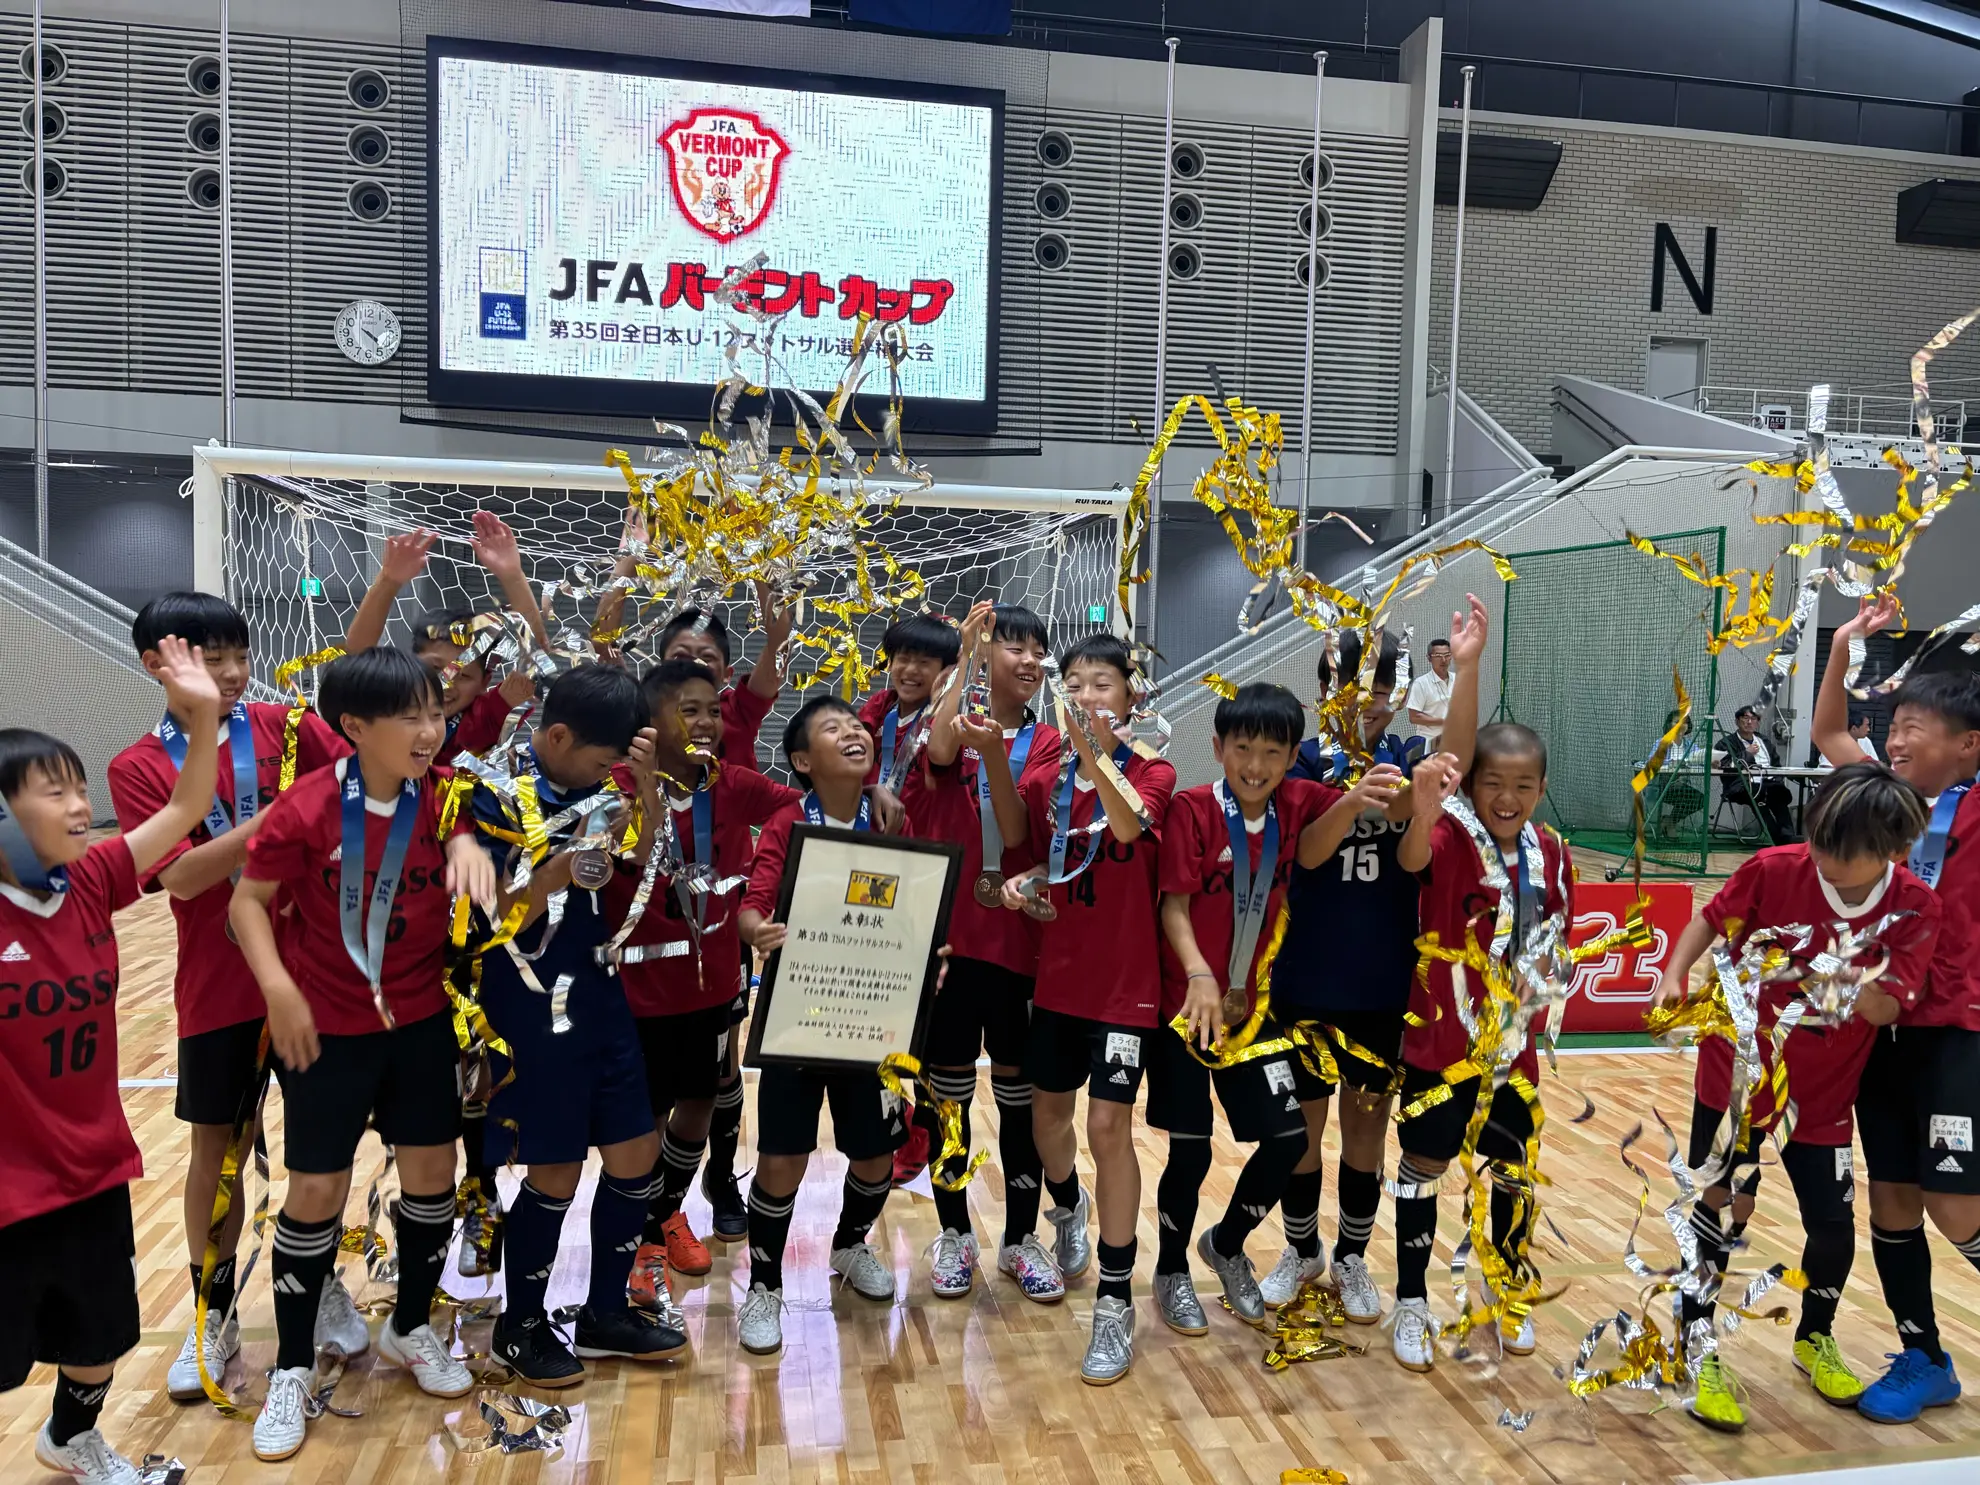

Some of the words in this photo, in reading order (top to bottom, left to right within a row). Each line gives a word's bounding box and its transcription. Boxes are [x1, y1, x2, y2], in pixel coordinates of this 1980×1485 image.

[710, 120, 737, 134] JFA
[678, 132, 770, 158] VERMONT
[706, 157, 743, 178] CUP
[1650, 222, 1718, 315] N
[548, 258, 653, 306] JFA
[364, 308, 374, 318] 12
[494, 309, 512, 318] U-12
[495, 302, 511, 310] JFA
[346, 317, 355, 327] 10
[342, 328, 350, 338] 9
[346, 337, 354, 347] 8
[364, 349, 372, 359] 6
[376, 347, 384, 357] 5
[162, 721, 177, 741] JFA
[346, 778, 360, 800] JFA
[241, 794, 253, 818] JFA
[860, 800, 869, 822] JFA
[1224, 797, 1239, 818] JFA
[1053, 833, 1064, 854] JFA
[1339, 843, 1380, 882] 15
[852, 874, 871, 884] JFA
[346, 886, 359, 912] JFA
[377, 878, 393, 905] JFA
[1237, 892, 1246, 914] JFA
[841, 910, 884, 929] 表彰状
[43, 1021, 98, 1078] 16
[1109, 1076, 1130, 1085] adidas
[1932, 1118, 1968, 1130] ミライ式
[1935, 1165, 1964, 1173] adidas
